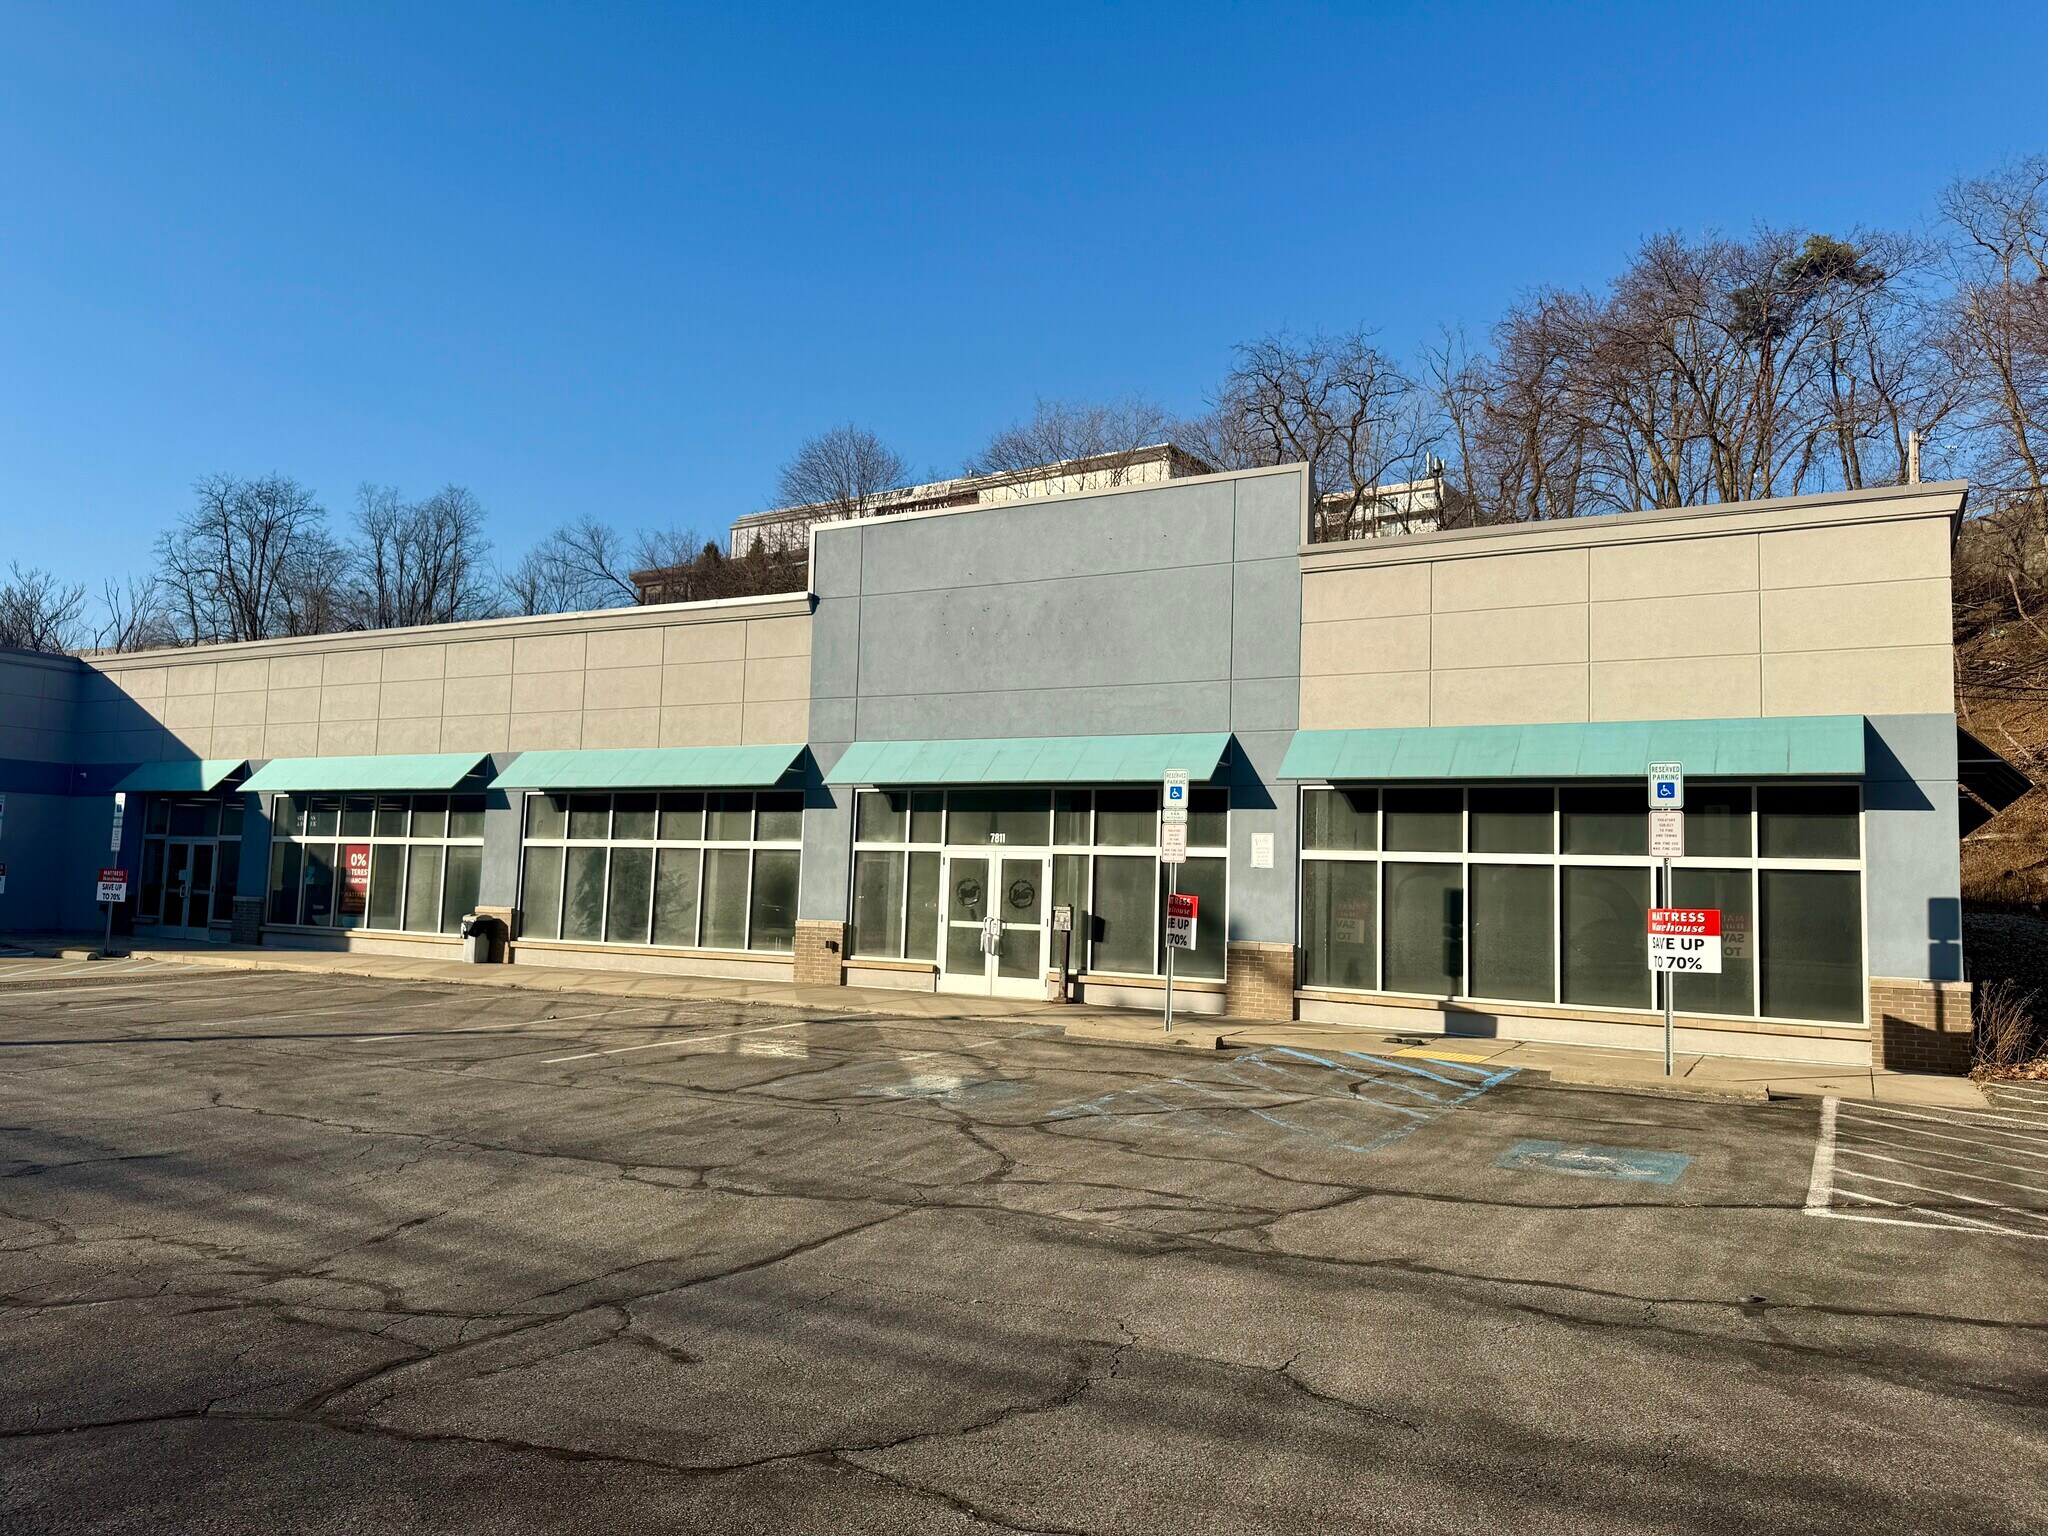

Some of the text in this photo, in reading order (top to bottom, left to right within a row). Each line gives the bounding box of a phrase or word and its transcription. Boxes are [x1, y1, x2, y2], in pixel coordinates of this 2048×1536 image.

[990, 833, 1006, 843] 7811
[351, 853, 367, 866] 0%
[1178, 919, 1189, 930] UP
[1169, 933, 1187, 946] 70%
[1652, 937, 1704, 950] SAVE UP
[1654, 955, 1702, 970] TO 70%
